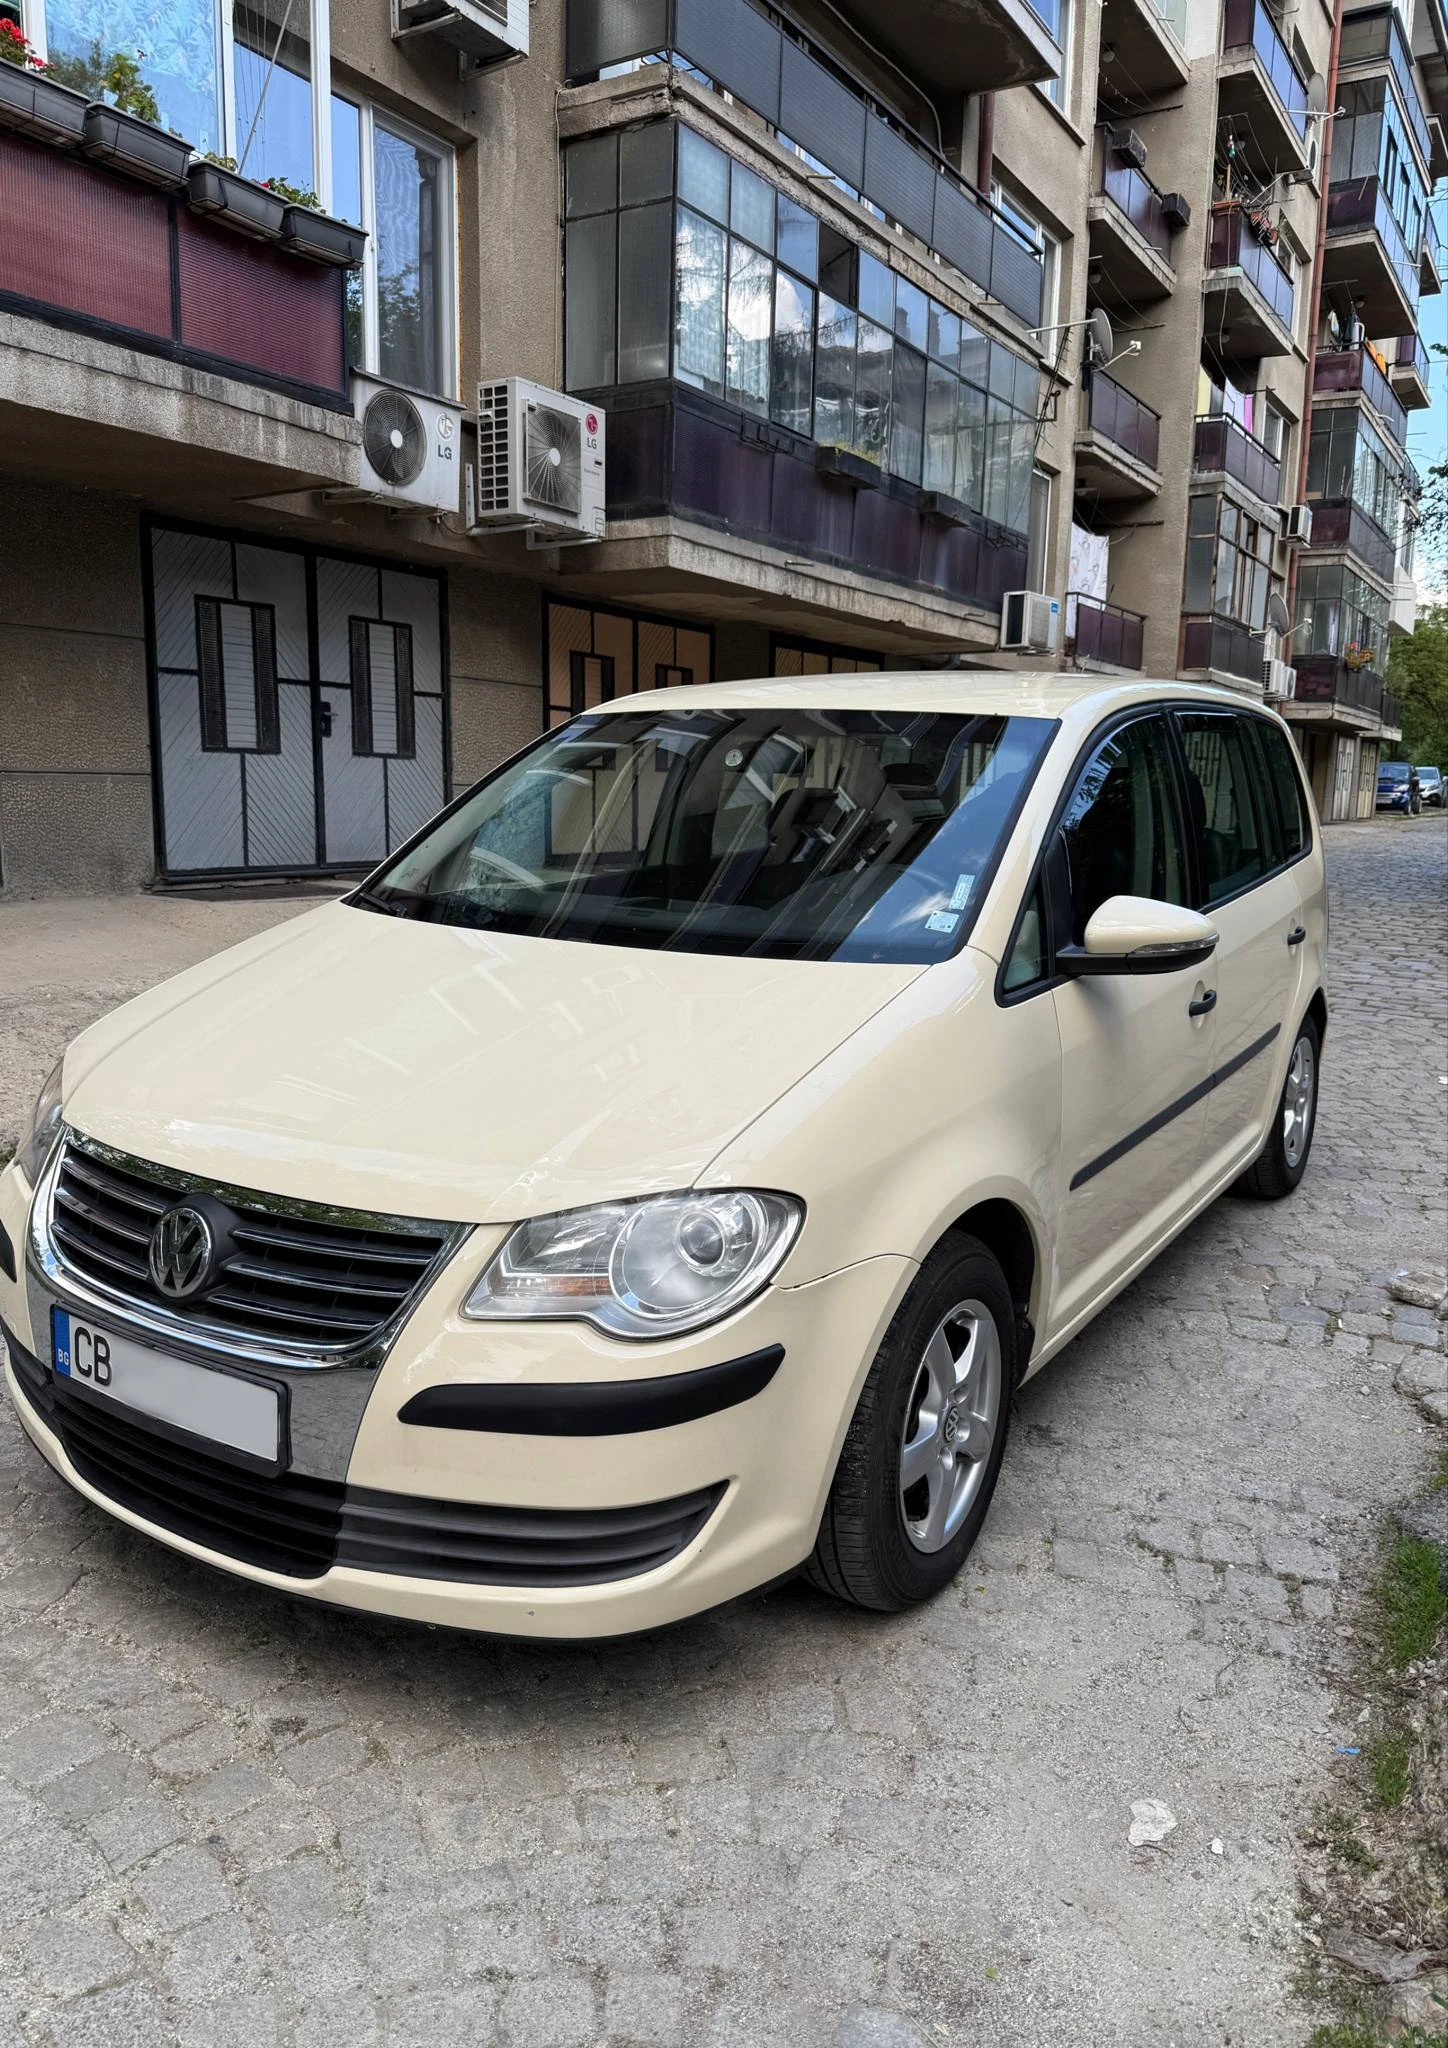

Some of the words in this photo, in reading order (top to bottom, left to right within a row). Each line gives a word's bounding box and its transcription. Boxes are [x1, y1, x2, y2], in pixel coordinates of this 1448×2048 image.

[437, 444, 452, 460] LG
[587, 437, 597, 450] LG
[150, 1207, 211, 1297] VW
[58, 1348, 69, 1366] BG
[74, 1326, 112, 1387] CB
